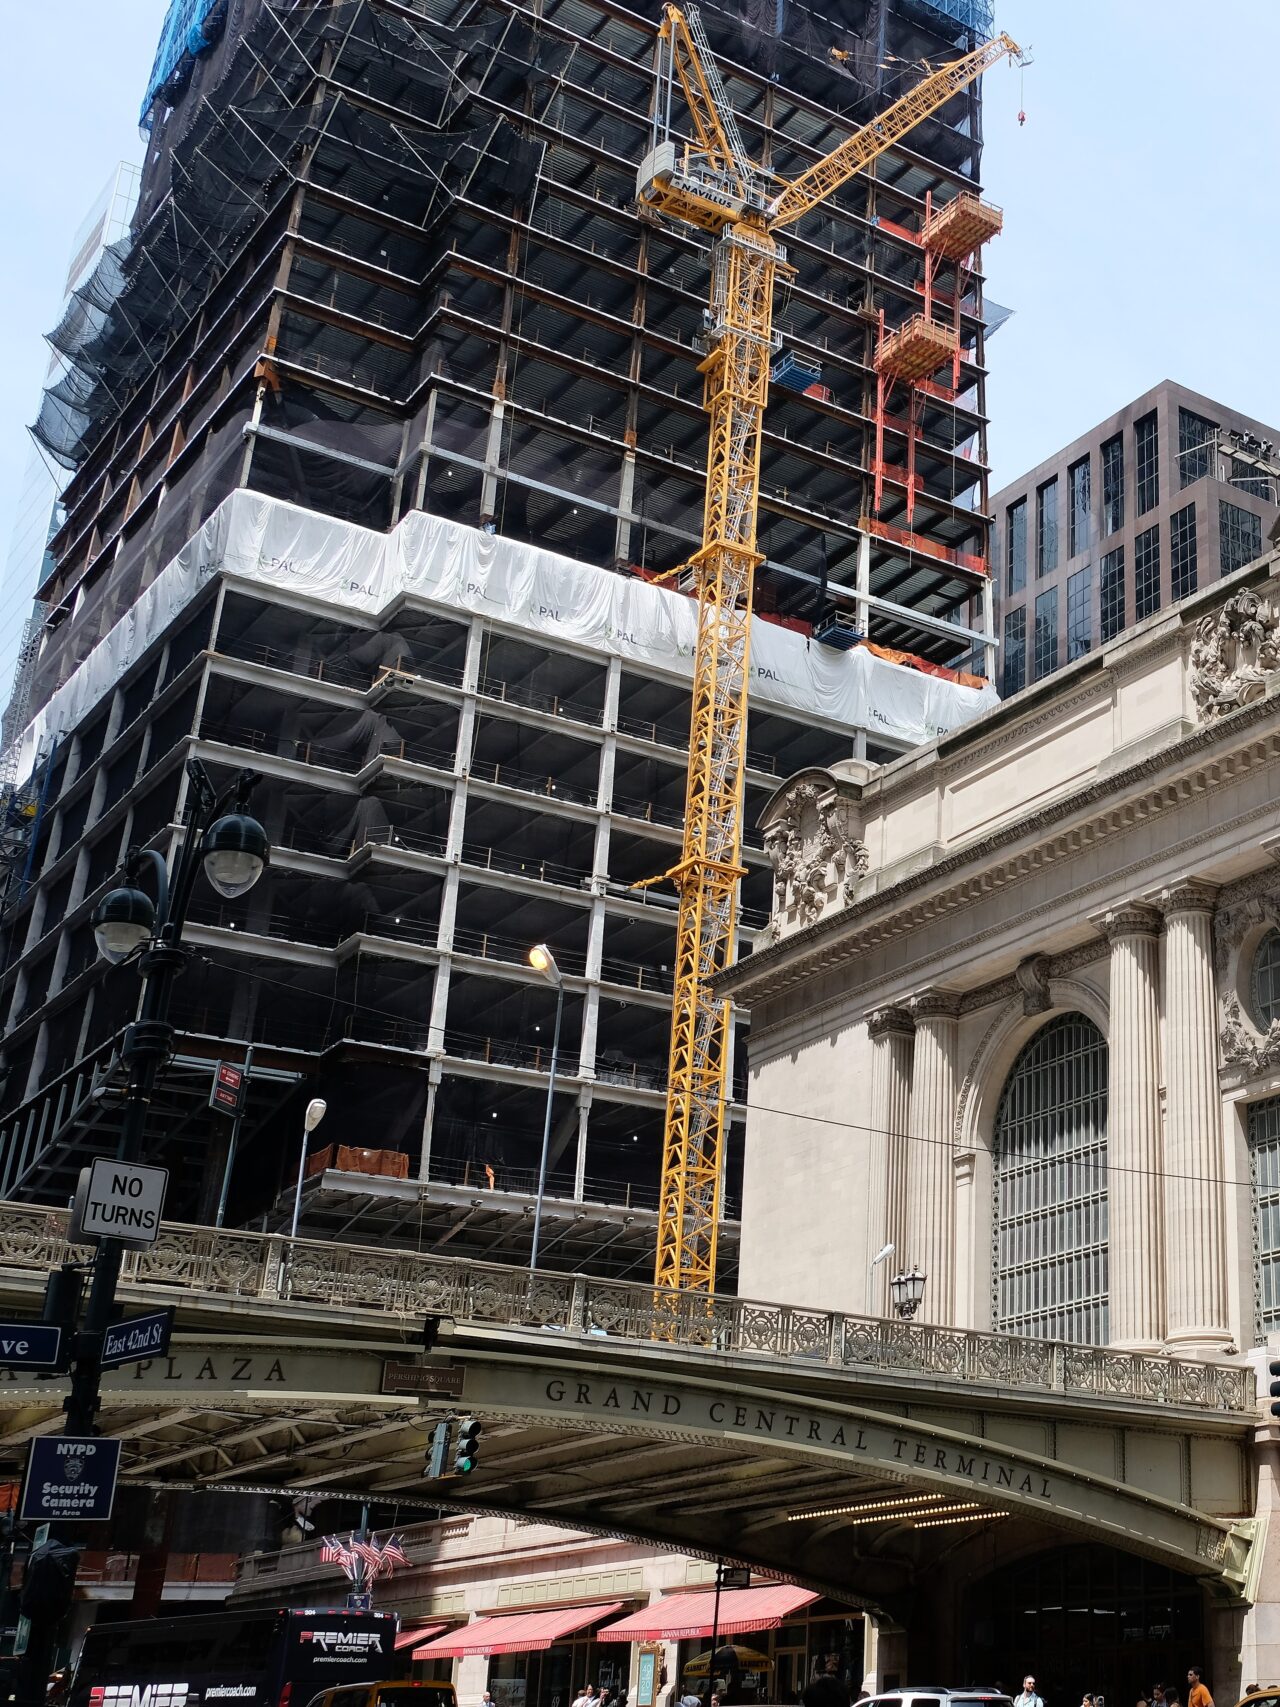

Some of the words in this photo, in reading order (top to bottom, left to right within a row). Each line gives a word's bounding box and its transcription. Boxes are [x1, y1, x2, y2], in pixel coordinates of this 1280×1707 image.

[682, 184, 732, 208] NAVILLUS
[758, 667, 780, 682] PAL
[112, 1174, 143, 1197] NO
[90, 1202, 156, 1229] TURNS
[0, 1340, 29, 1355] ve
[104, 1334, 126, 1356] East
[127, 1329, 149, 1350] 42nd
[151, 1324, 163, 1345] St
[133, 1356, 286, 1381] PLAZA
[429, 1376, 460, 1384] SQUARE
[546, 1380, 681, 1416] GRAND
[709, 1402, 868, 1450] CENTRAL
[893, 1438, 1052, 1498] TERMINAL
[56, 1444, 96, 1455] NYPD
[42, 1482, 98, 1497] Security
[42, 1496, 94, 1507] Camera
[205, 1684, 256, 1700] premiercoach.com
